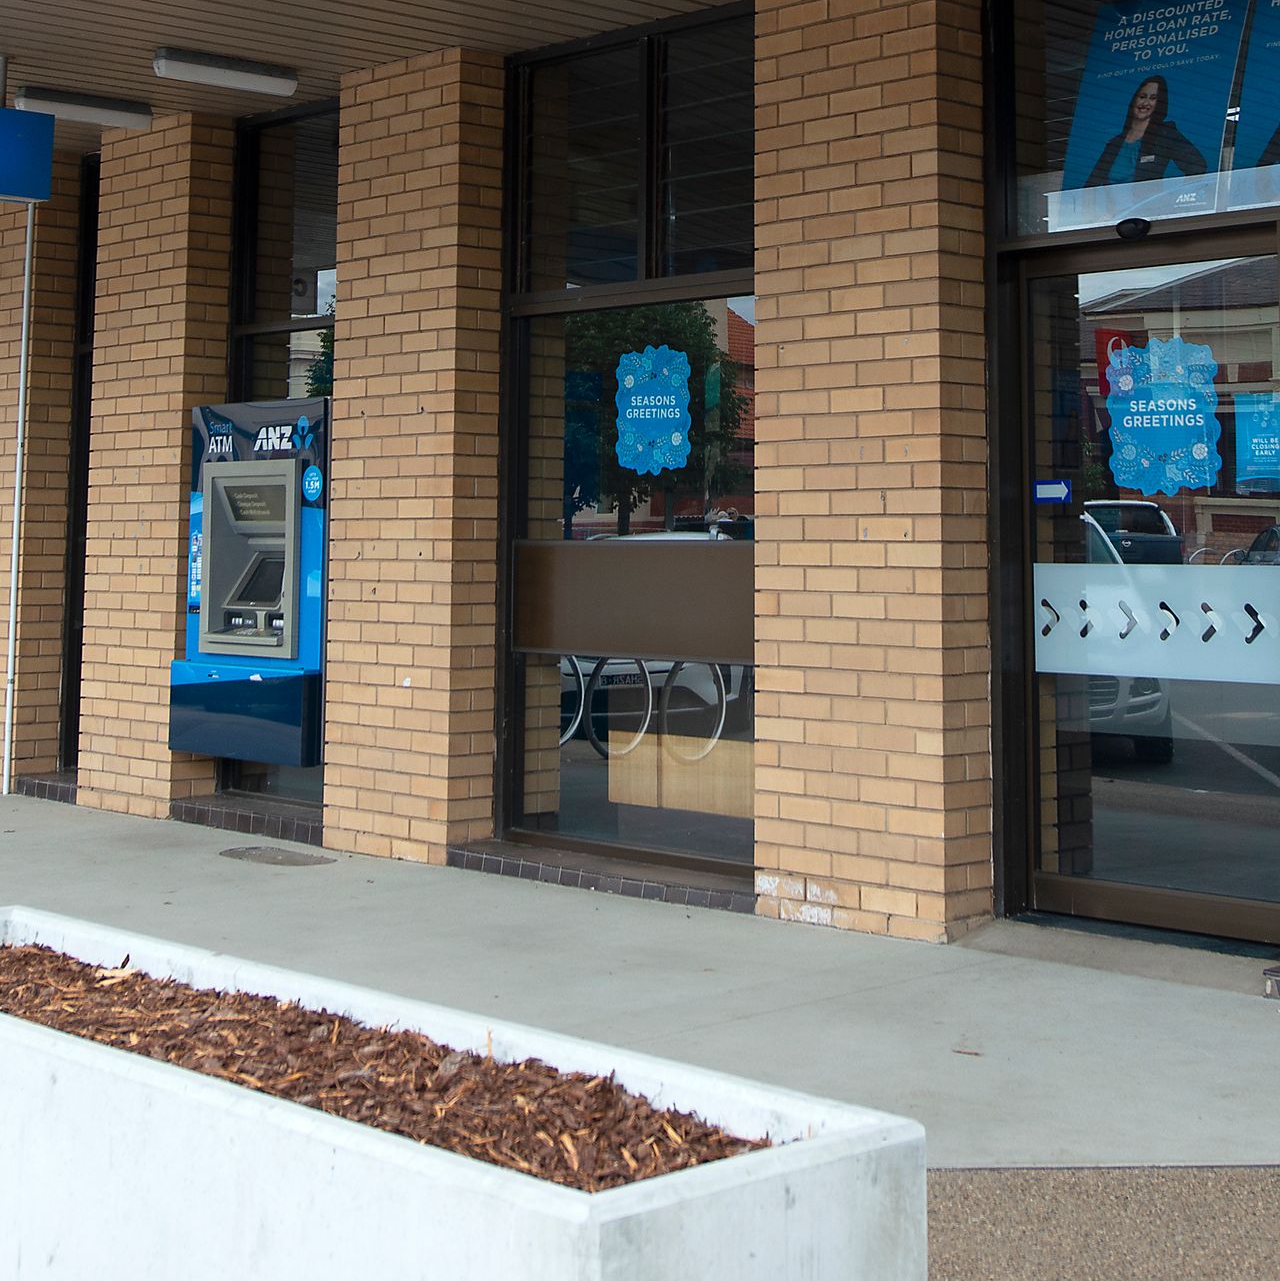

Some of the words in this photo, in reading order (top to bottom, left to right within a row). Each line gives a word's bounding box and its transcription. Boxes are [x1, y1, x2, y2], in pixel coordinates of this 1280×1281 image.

[1104, 25, 1144, 41] HOME
[1149, 17, 1187, 33] LOAN
[1191, 10, 1232, 25] RATE,
[1118, 16, 1127, 26] A
[1111, 25, 1219, 52] PERSONALISED
[1134, 50, 1152, 61] TO
[1157, 43, 1189, 57] YOU.
[1176, 193, 1196, 203] ANZ
[631, 395, 676, 406] SEASONS
[1130, 399, 1197, 412] SEASONS
[626, 408, 680, 418] GREETINGS
[1123, 414, 1204, 427] GREETINGS
[210, 422, 233, 434] Smart
[253, 426, 293, 451] ANZ
[208, 436, 233, 453] ATM
